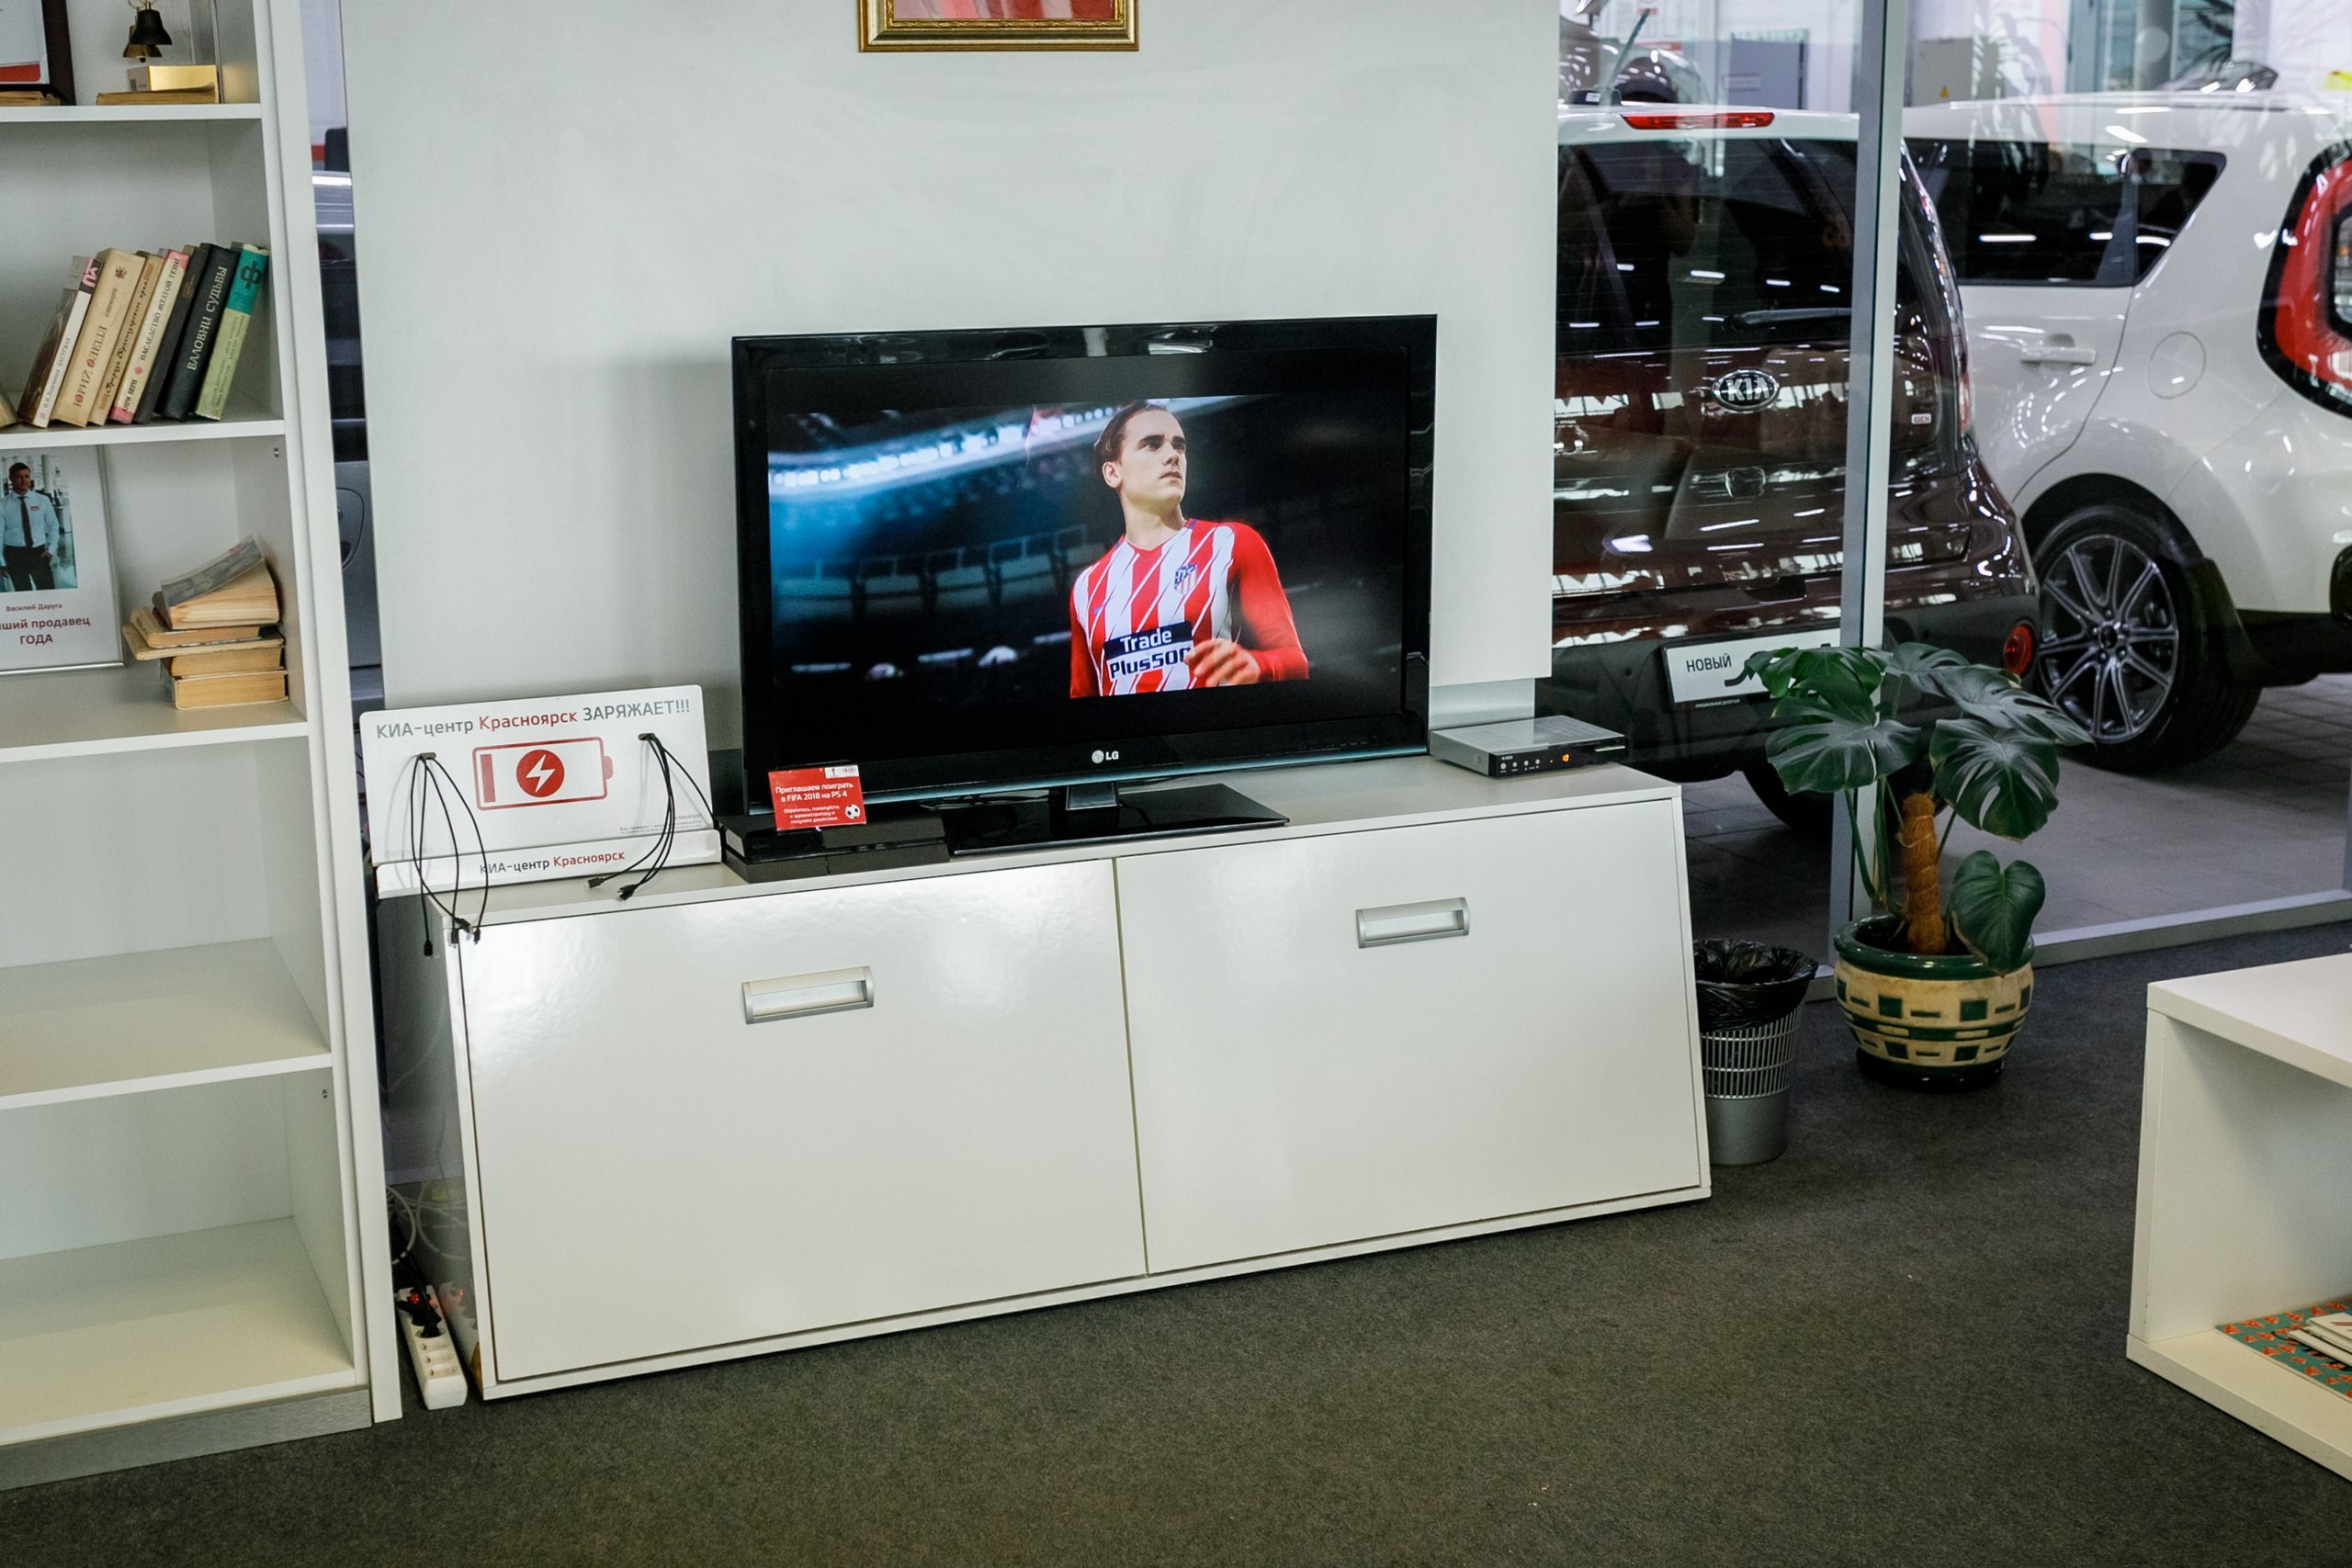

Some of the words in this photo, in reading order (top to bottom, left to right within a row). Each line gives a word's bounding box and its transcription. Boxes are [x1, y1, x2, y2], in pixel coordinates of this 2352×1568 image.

[140, 311, 161, 361] НАСЛЕДСТВО
[169, 258, 180, 278] ТЕНИ
[187, 316, 211, 371] БАЛОВНИ
[206, 265, 228, 313] СУДЬБЫ
[73, 372, 91, 407] ЮРИЙ
[86, 326, 107, 367] ОЛЕША
[1726, 378, 1770, 401] KIA
[6, 604, 36, 612] Василий
[38, 603, 62, 611] Даруга
[0, 619, 28, 630] ший
[31, 617, 91, 630] продавец
[20, 634, 53, 645] ГОДА
[1120, 627, 1172, 653] Trade
[1686, 653, 1732, 672] НОВЫЙ
[377, 720, 474, 739] КИА-центр
[479, 711, 577, 732] Красноярск
[582, 699, 690, 721] ЗАРЯЖАЕТ!!!
[1105, 750, 1119, 761] LG
[775, 784, 820, 795] Приглашаем
[821, 783, 854, 791] поиграть
[480, 860, 549, 874] КИА-центр
[553, 852, 625, 868] Красноярск
